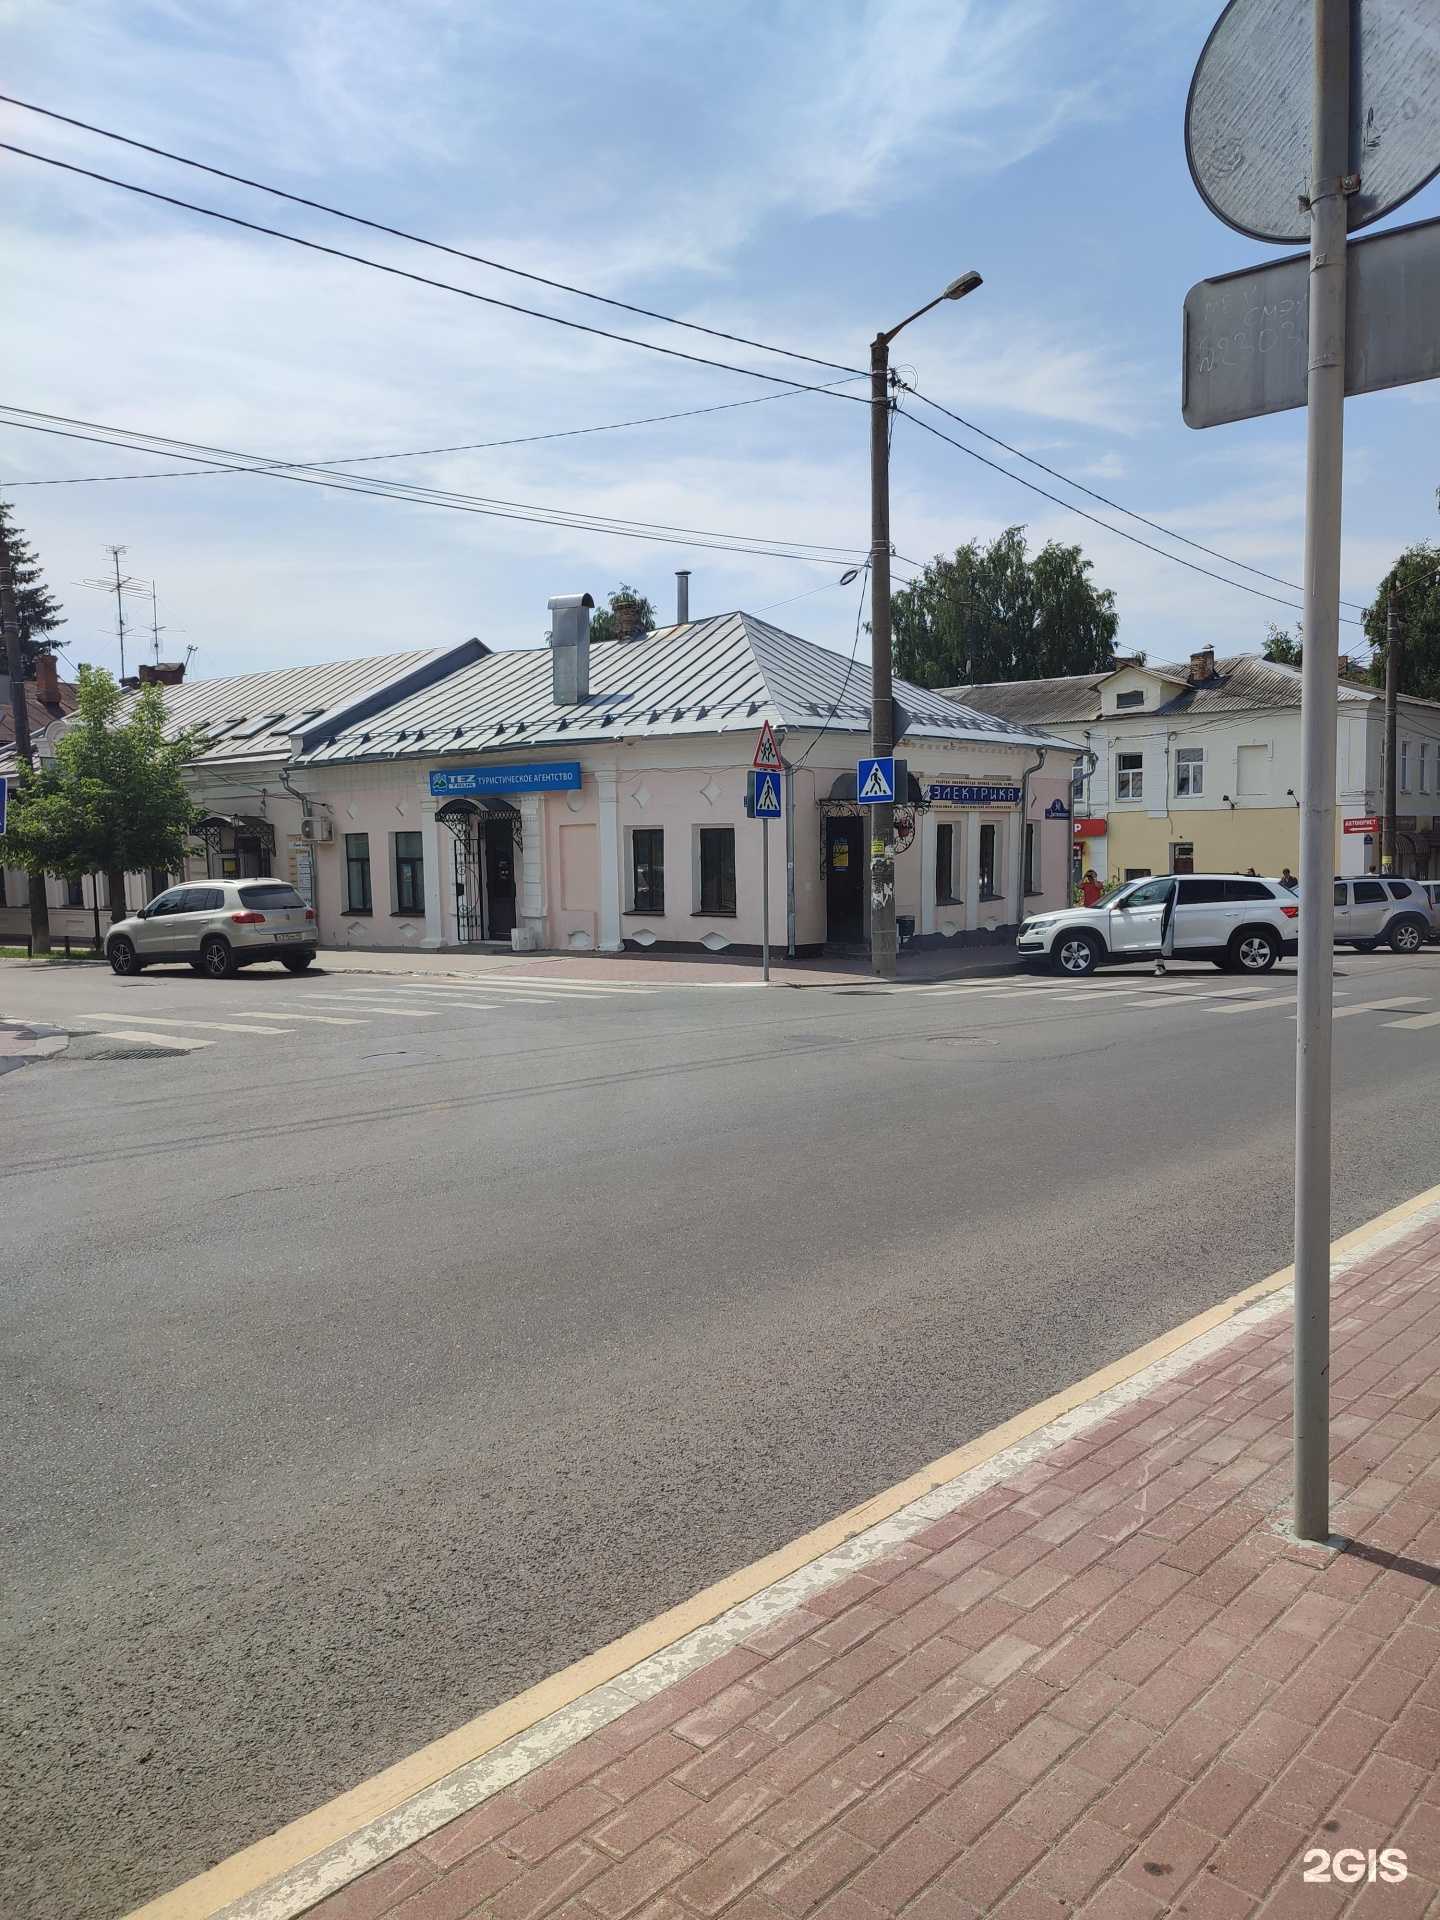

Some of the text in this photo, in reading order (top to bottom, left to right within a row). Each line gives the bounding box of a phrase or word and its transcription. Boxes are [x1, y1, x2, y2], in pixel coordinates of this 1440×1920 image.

[448, 774, 476, 783] TEZ
[478, 772, 573, 785] ТУРИСТИЧЕСКОЕ АГЕНТСТВО
[933, 786, 1014, 801] ЭЛЕКТРИКА
